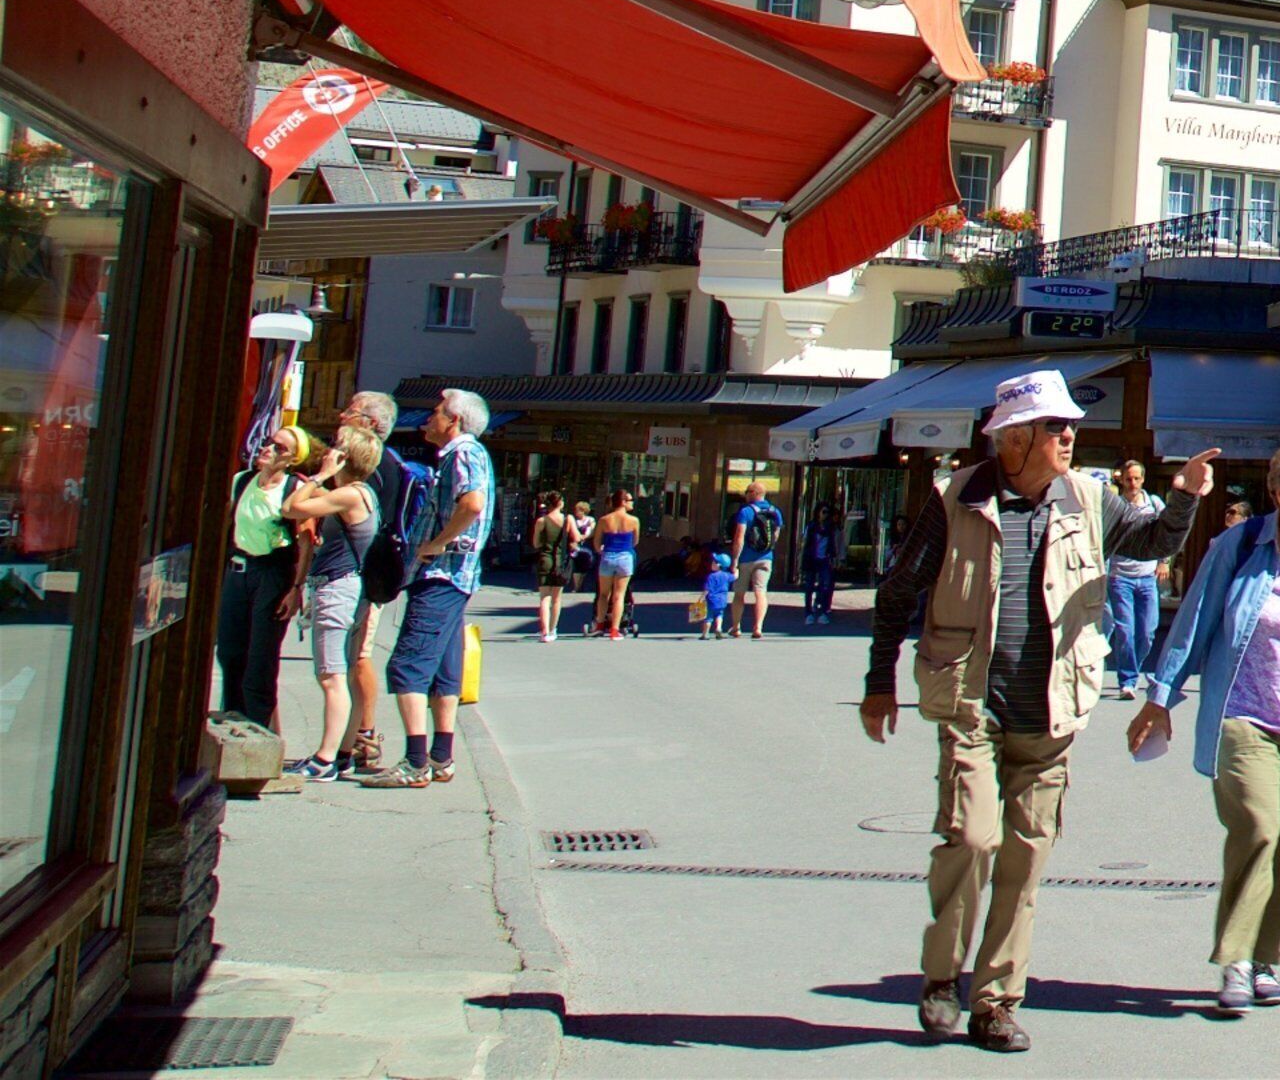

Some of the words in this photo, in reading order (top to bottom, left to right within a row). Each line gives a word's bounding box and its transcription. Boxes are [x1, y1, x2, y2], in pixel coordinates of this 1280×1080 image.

[263, 108, 308, 150] OFFICE
[1164, 116, 1202, 136] Villa
[1044, 285, 1092, 296] BERDOZ
[664, 437, 687, 447] UBS
